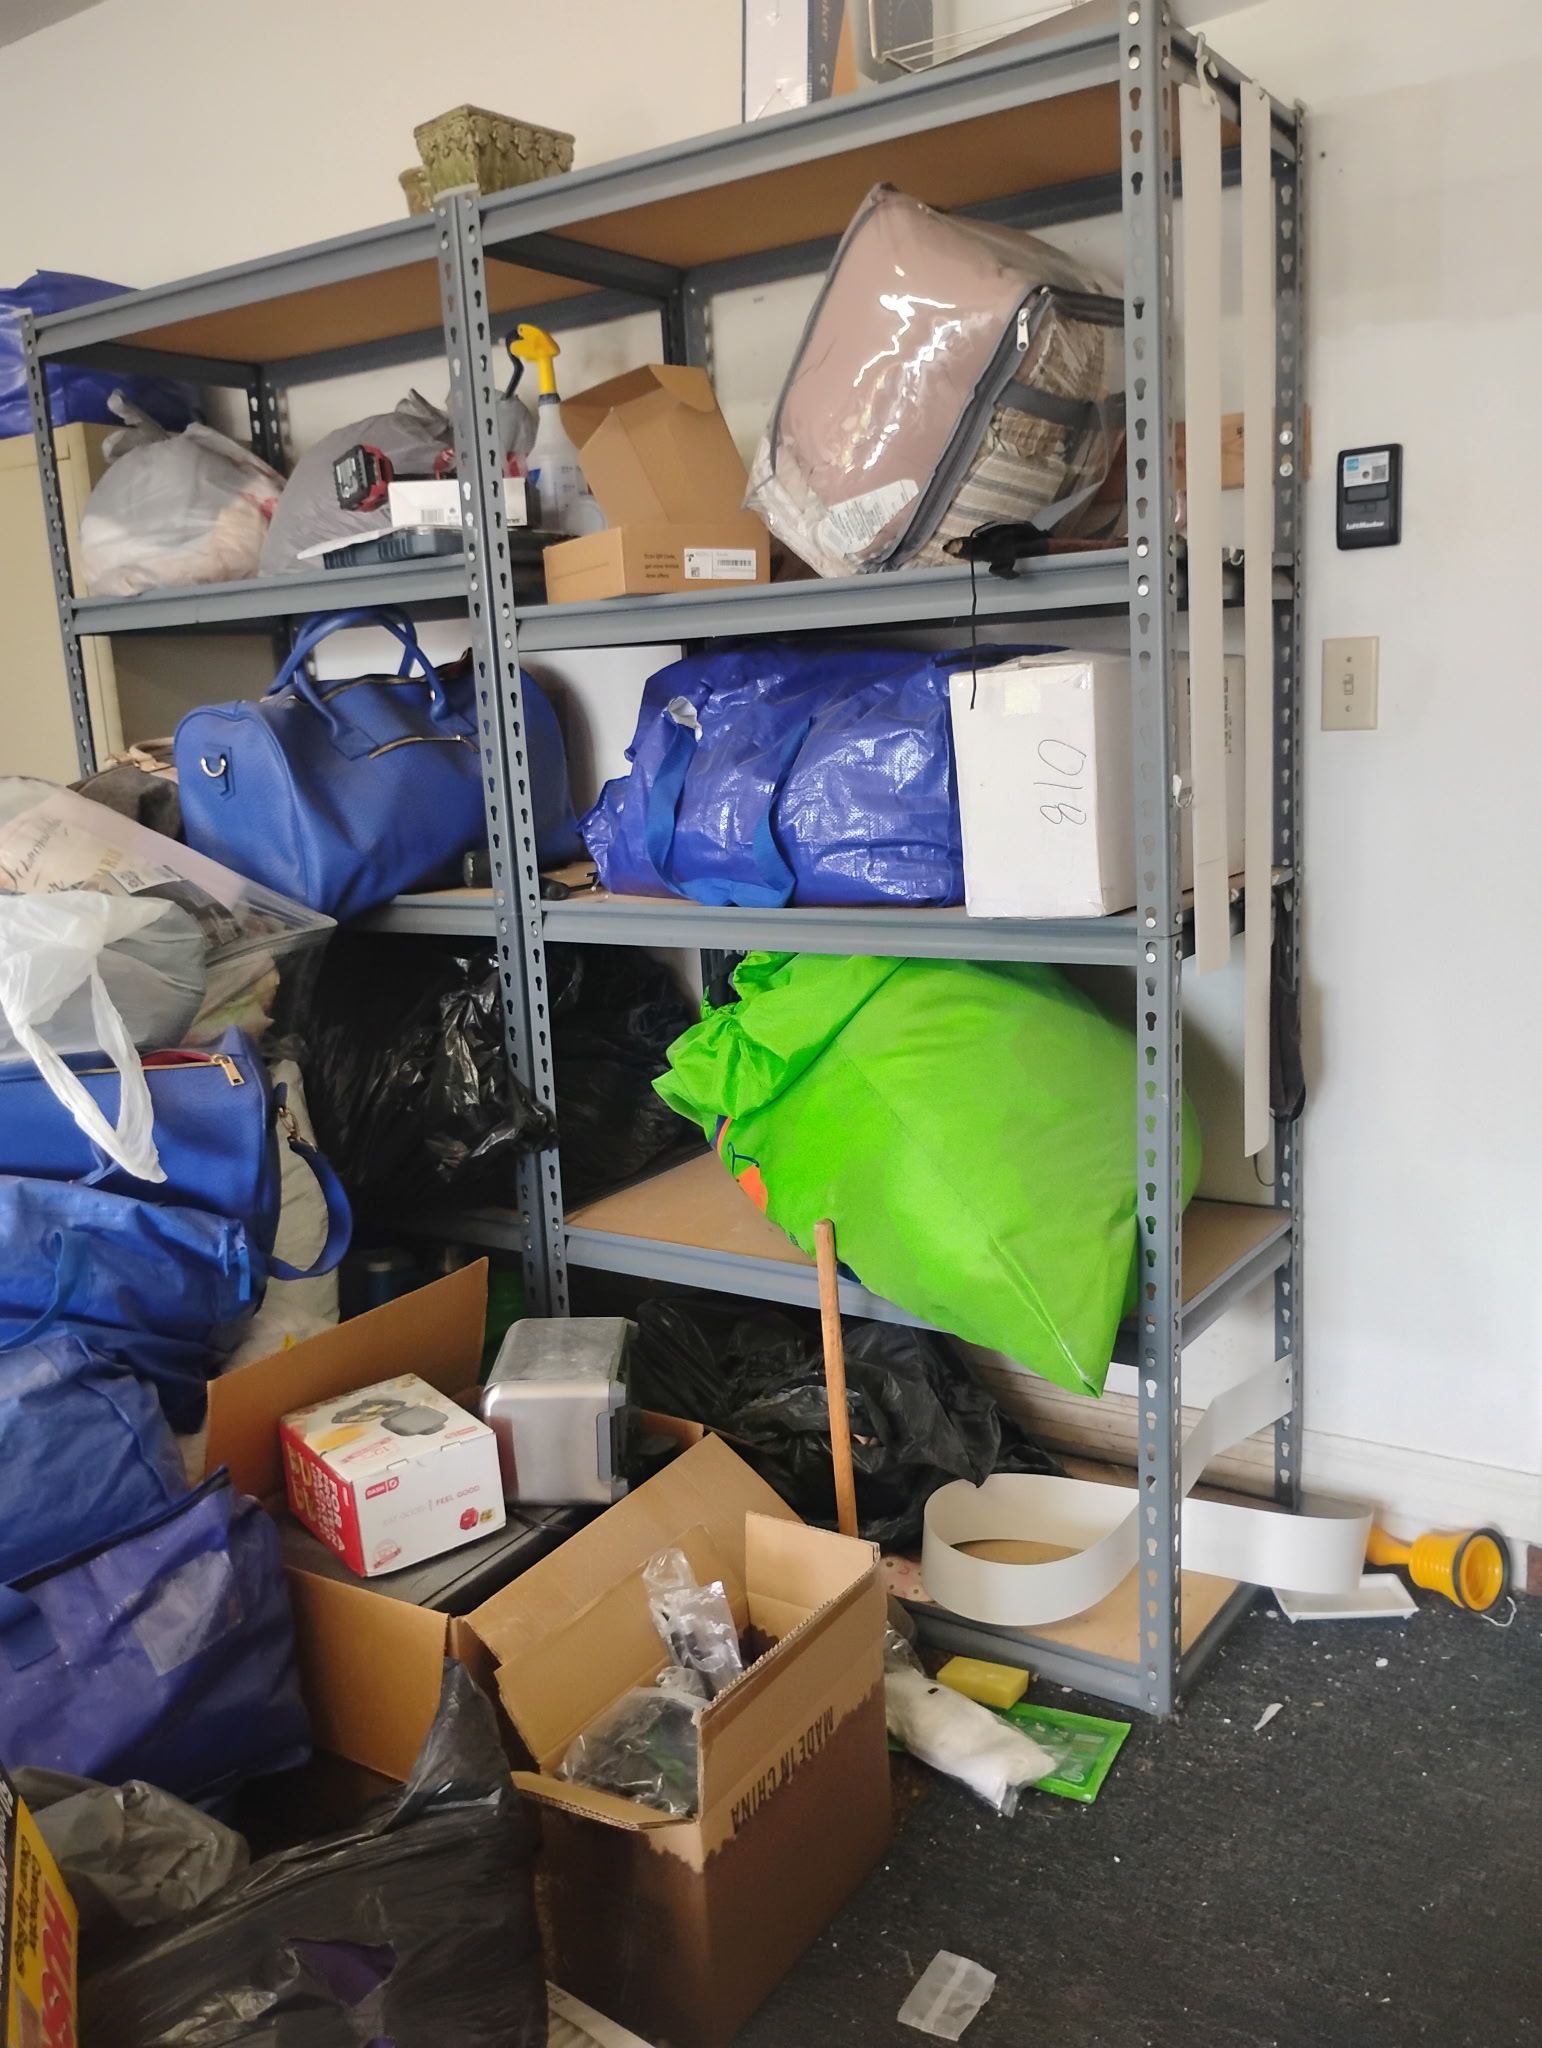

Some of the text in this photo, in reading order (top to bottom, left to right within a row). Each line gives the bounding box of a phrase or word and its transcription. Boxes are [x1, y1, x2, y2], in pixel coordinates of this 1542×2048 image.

[436, 1494, 454, 1507] FEEL
[456, 1484, 480, 1499] GOOD
[730, 1705, 834, 1835] MADE IN CHINA
[42, 1878, 74, 2048] HUS
